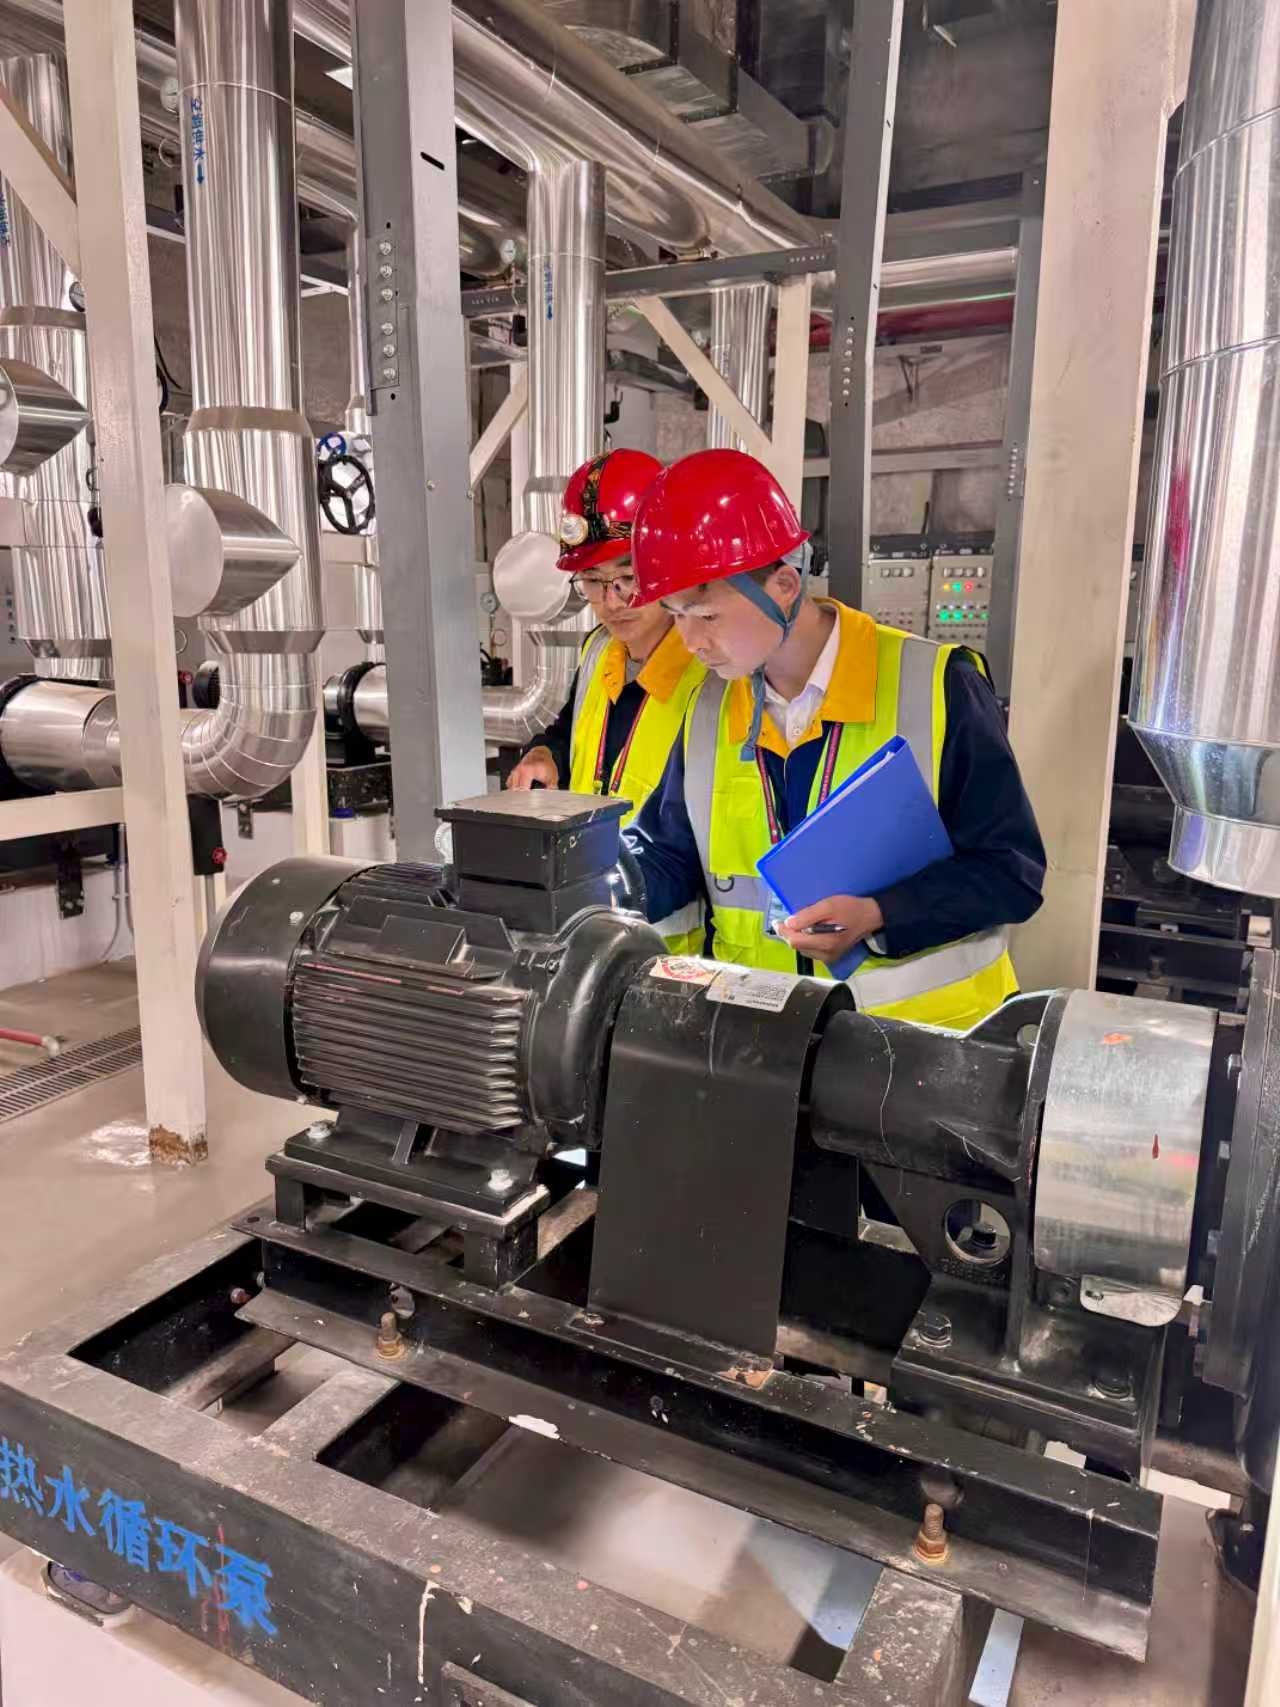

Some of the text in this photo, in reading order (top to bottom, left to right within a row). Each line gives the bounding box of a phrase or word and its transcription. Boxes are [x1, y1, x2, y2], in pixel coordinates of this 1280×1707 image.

[0, 1436, 278, 1635] 热水循环泵
